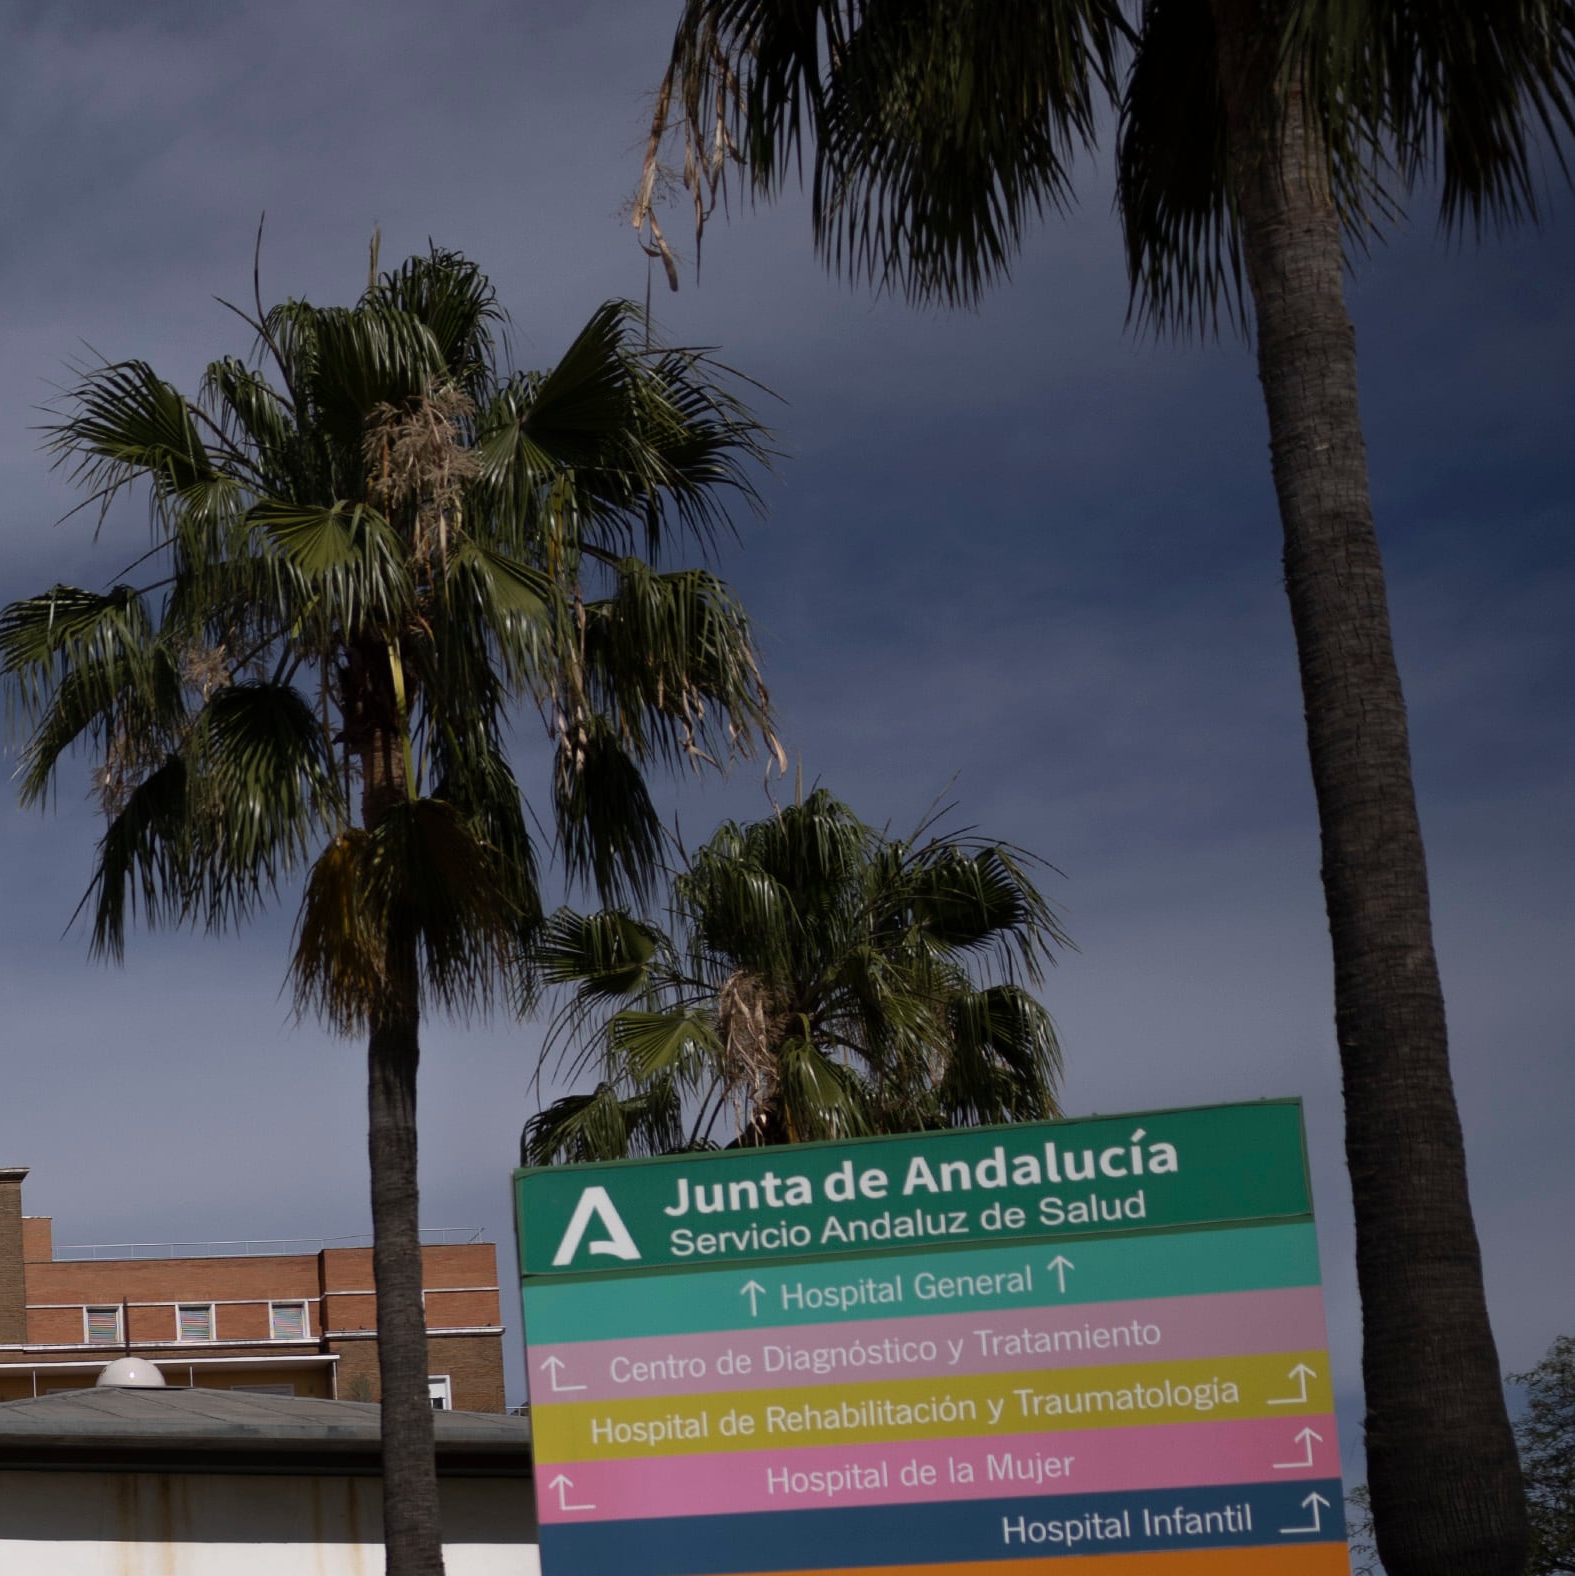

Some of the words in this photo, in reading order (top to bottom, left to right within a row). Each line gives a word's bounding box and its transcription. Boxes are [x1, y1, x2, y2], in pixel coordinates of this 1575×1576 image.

[664, 1171, 813, 1217] Junta
[824, 1160, 888, 1202] de
[902, 1128, 1178, 1196] Andalucía
[670, 1220, 812, 1257] Servicio
[820, 1209, 969, 1245] Andaluz
[980, 1202, 1027, 1231] de
[1039, 1190, 1147, 1226] Salud
[781, 1275, 904, 1312] Hospital
[913, 1264, 1033, 1300] General
[610, 1354, 707, 1383] Centro
[717, 1350, 752, 1375] de
[763, 1337, 938, 1374] Diagnóstico
[946, 1337, 964, 1365] y
[973, 1319, 1161, 1357] Tratamiento
[591, 1411, 709, 1446] Hospital
[719, 1409, 755, 1436] de
[766, 1395, 977, 1433] Rehabilitación
[987, 1397, 1004, 1424] y
[1013, 1377, 1240, 1416] Traumatología
[767, 1461, 889, 1496] Hospital
[900, 1459, 937, 1486] de
[948, 1456, 975, 1483] la
[987, 1452, 1076, 1484] Mujer
[1002, 1509, 1131, 1547] Hospital
[1143, 1503, 1253, 1537] Infantil
